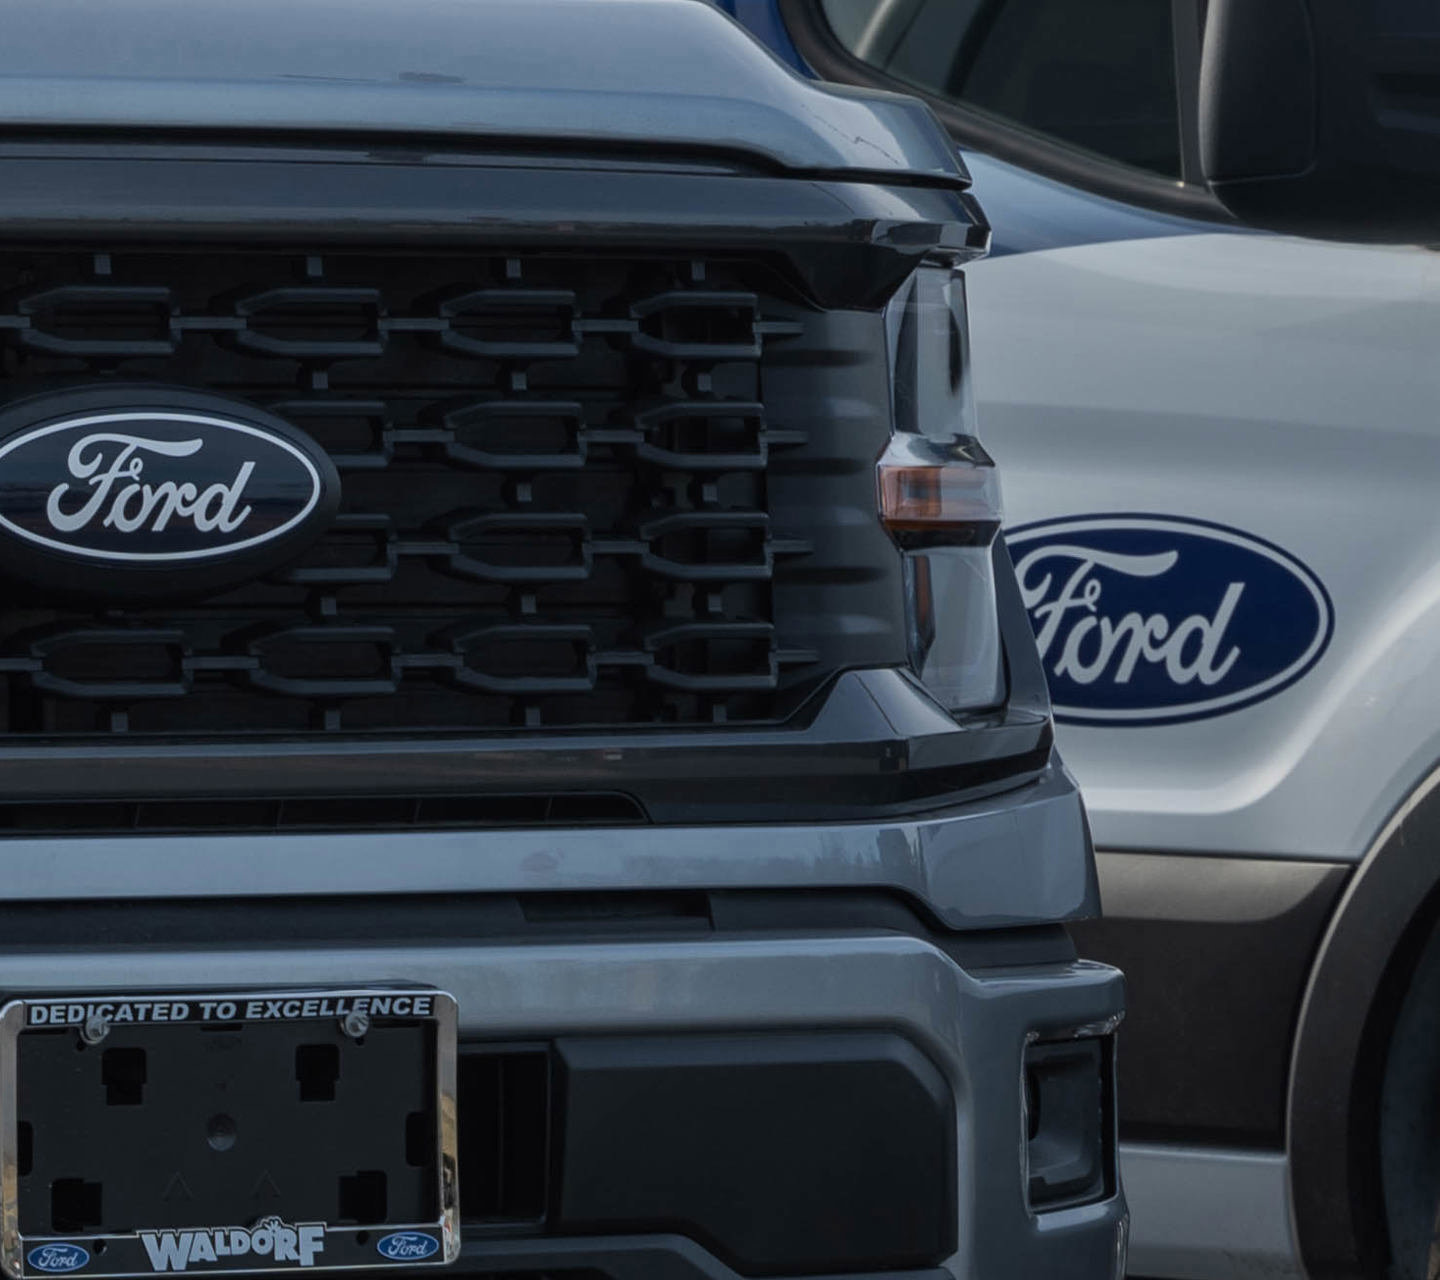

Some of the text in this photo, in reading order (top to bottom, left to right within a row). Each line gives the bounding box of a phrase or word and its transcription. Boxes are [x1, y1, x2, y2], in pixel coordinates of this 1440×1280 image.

[46, 433, 256, 532] Ford
[1014, 544, 1246, 686] Ford
[30, 996, 432, 1025] DEDICATED TO EXCELLENCE
[32, 1247, 80, 1269] Ford
[381, 1235, 430, 1258] Ford
